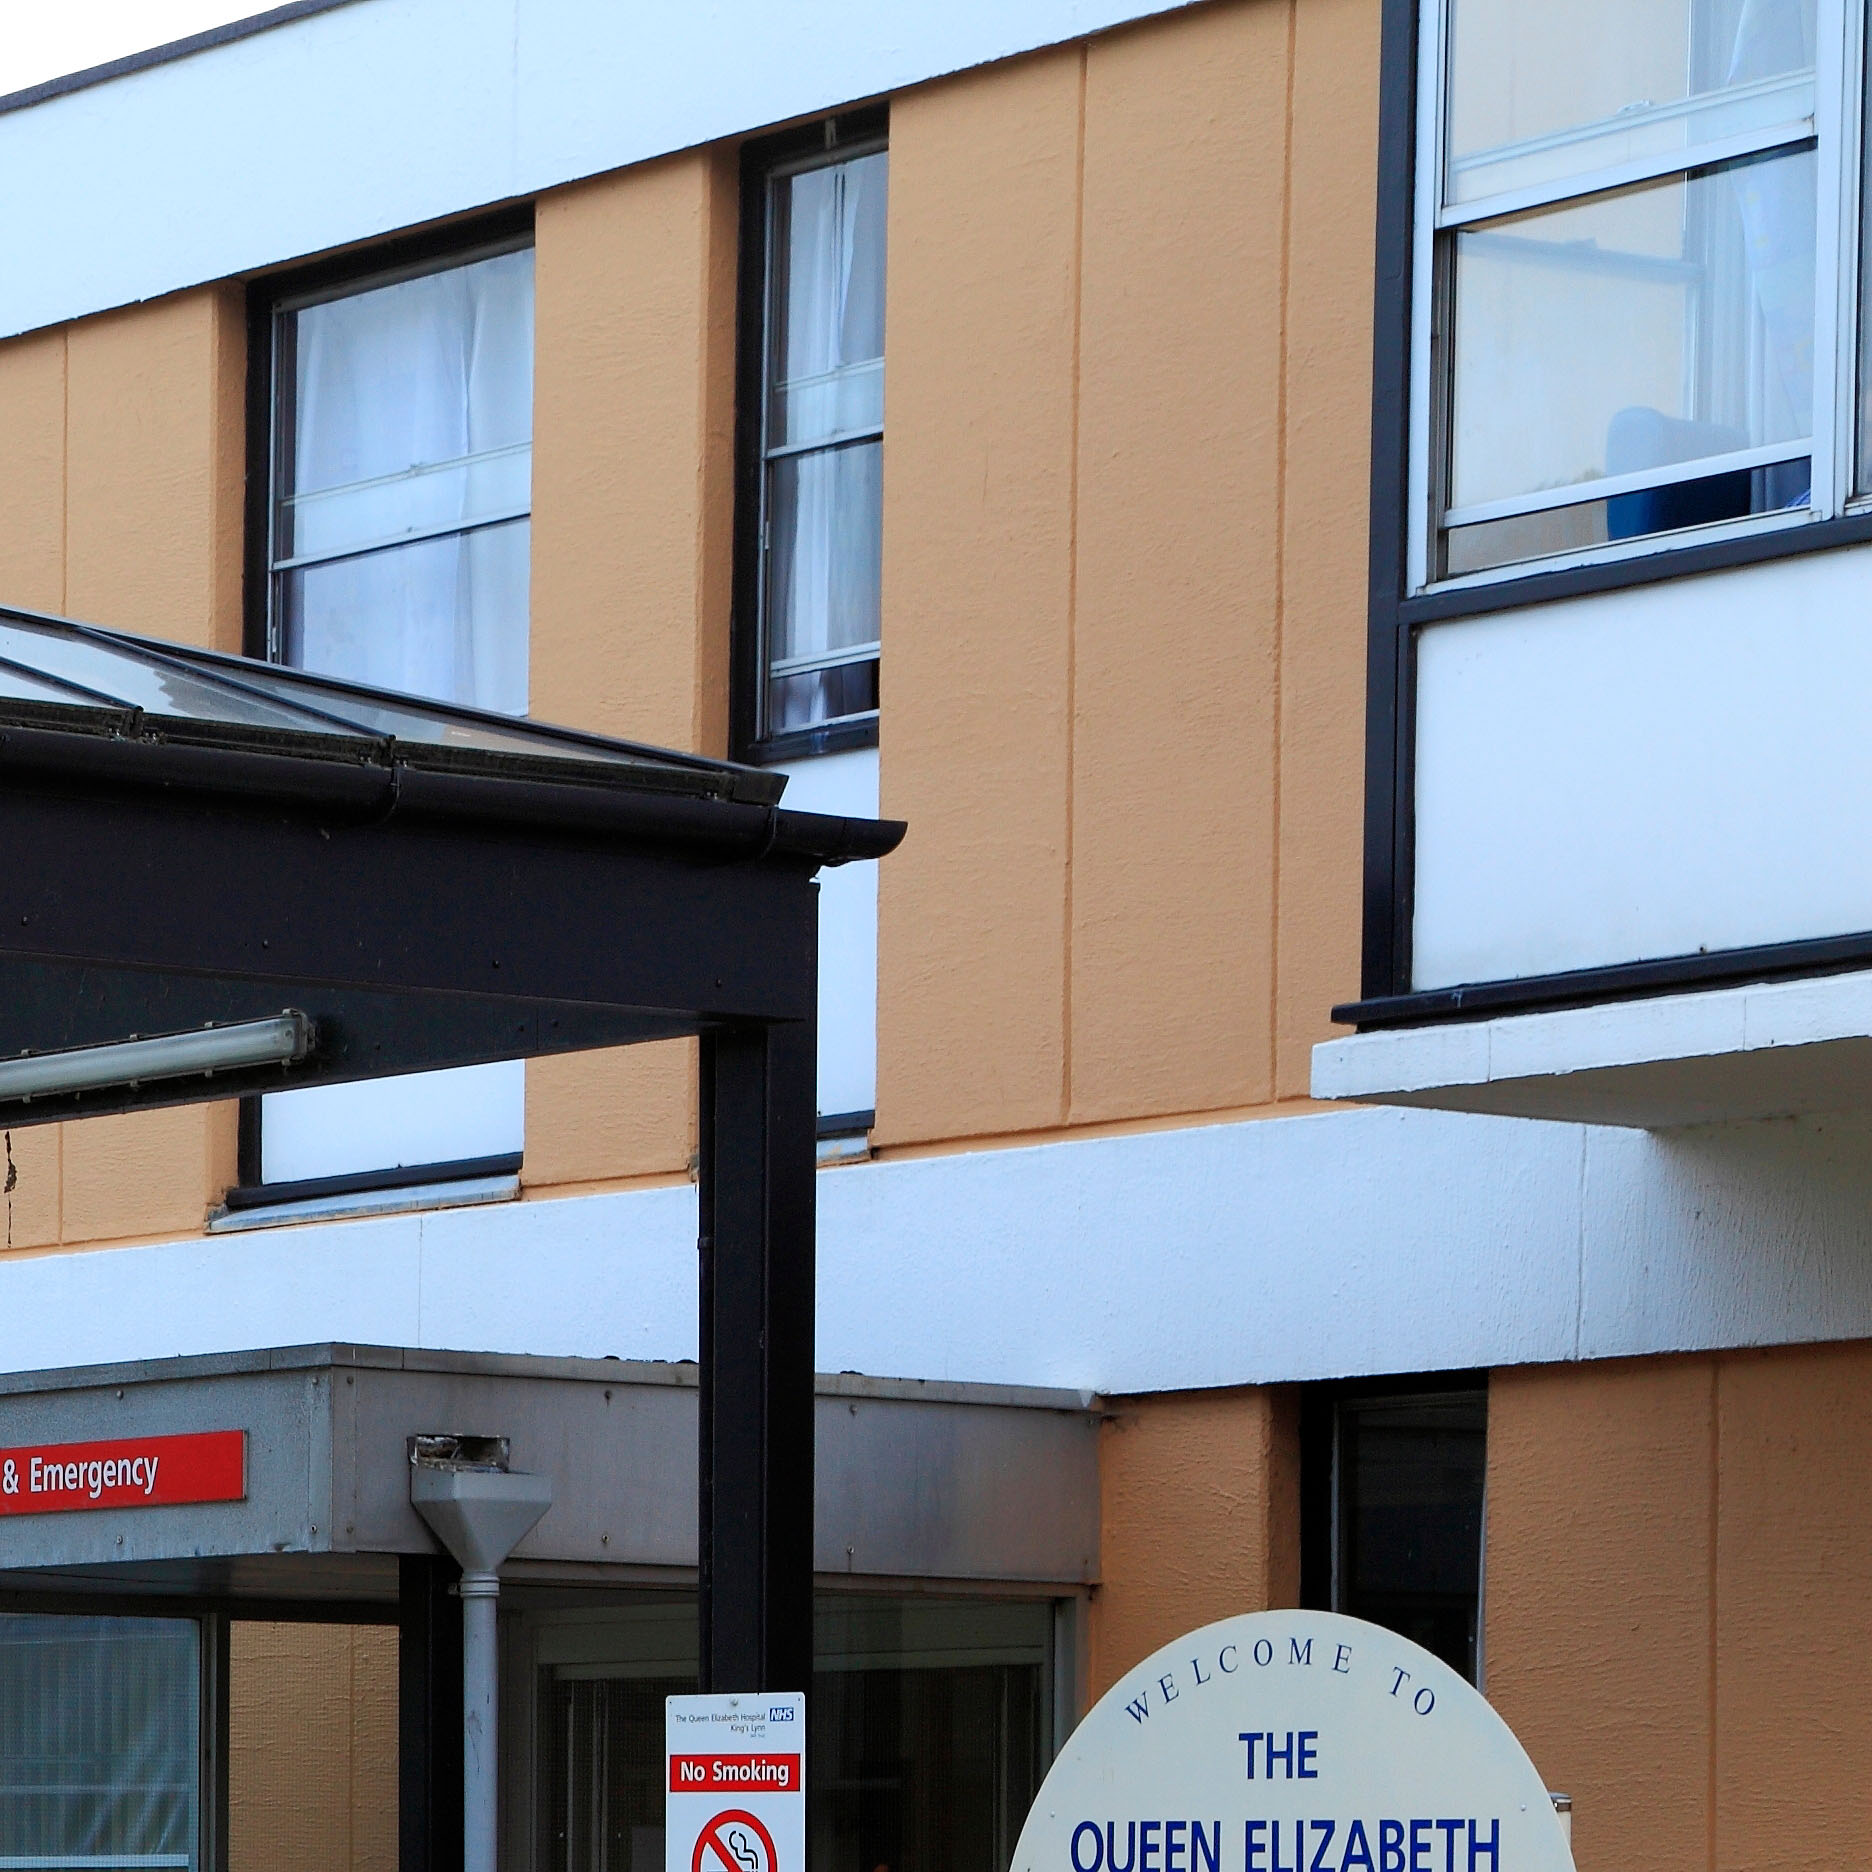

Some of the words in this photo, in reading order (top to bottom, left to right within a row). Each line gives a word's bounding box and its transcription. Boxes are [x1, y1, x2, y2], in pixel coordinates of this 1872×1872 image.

[3, 1459, 19, 1493] &
[29, 1454, 160, 1500] Emergency
[1124, 1637, 1353, 1726] WELCOME
[1390, 1665, 1437, 1717] TO
[676, 1714, 687, 1723] The
[689, 1714, 709, 1723] Queen
[711, 1713, 739, 1722] Elizabeth
[741, 1713, 766, 1723] Hospital
[770, 1708, 794, 1721] NHS
[751, 1724, 766, 1733] Lynn
[680, 1761, 706, 1781] No
[712, 1759, 789, 1786] Smoking
[1238, 1731, 1319, 1780] THE
